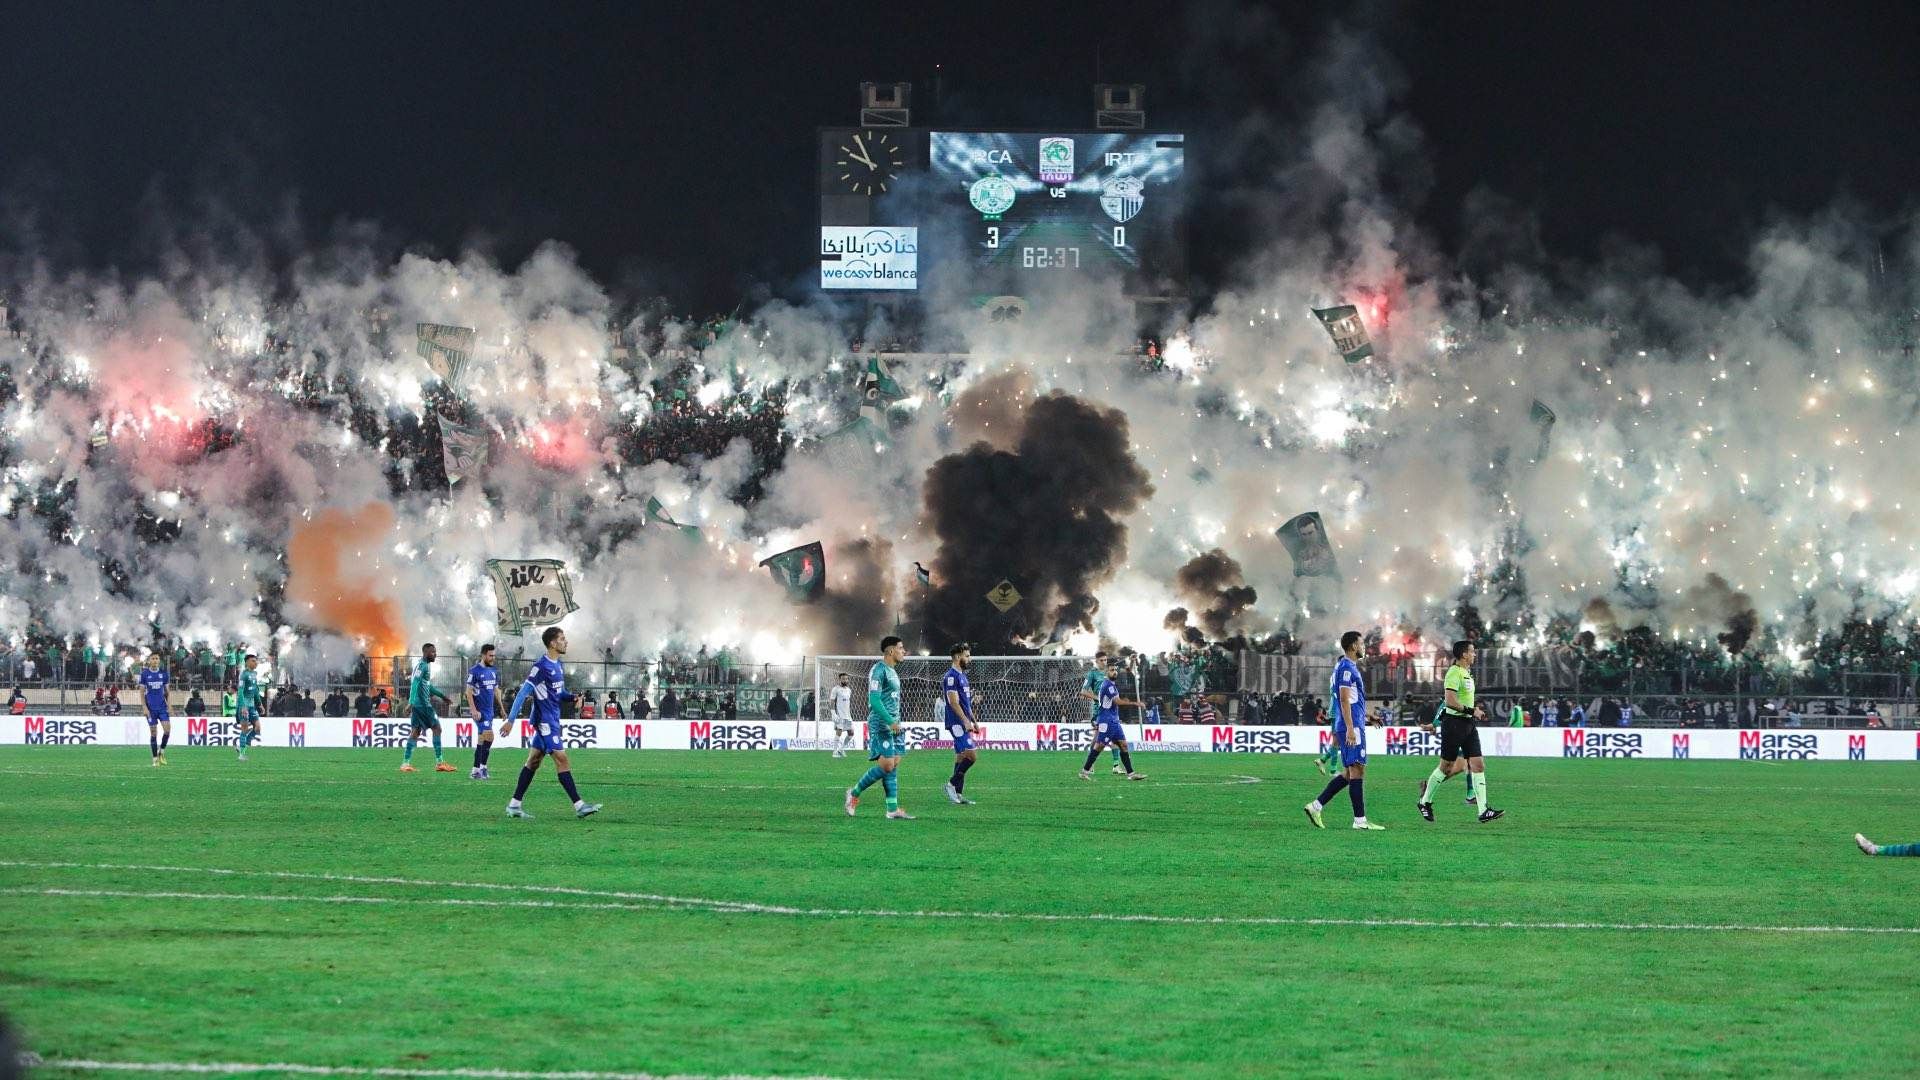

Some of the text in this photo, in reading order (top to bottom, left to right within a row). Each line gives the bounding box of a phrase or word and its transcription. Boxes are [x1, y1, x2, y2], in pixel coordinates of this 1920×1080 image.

[974, 150, 1012, 163] RCA
[1104, 152, 1136, 166] IRT
[987, 227, 999, 248] 3
[1113, 226, 1125, 247] 0
[1023, 247, 1080, 268] 62:37
[506, 565, 544, 589] til
[519, 598, 561, 617] ath
[25, 717, 97, 734] Marsa
[352, 719, 427, 737] Mars
[521, 720, 597, 738] Mrsa
[690, 722, 767, 739] Marsa
[1212, 727, 1290, 744] Marsa
[1563, 729, 1642, 747] Marsa
[1740, 731, 1818, 748] Marsa
